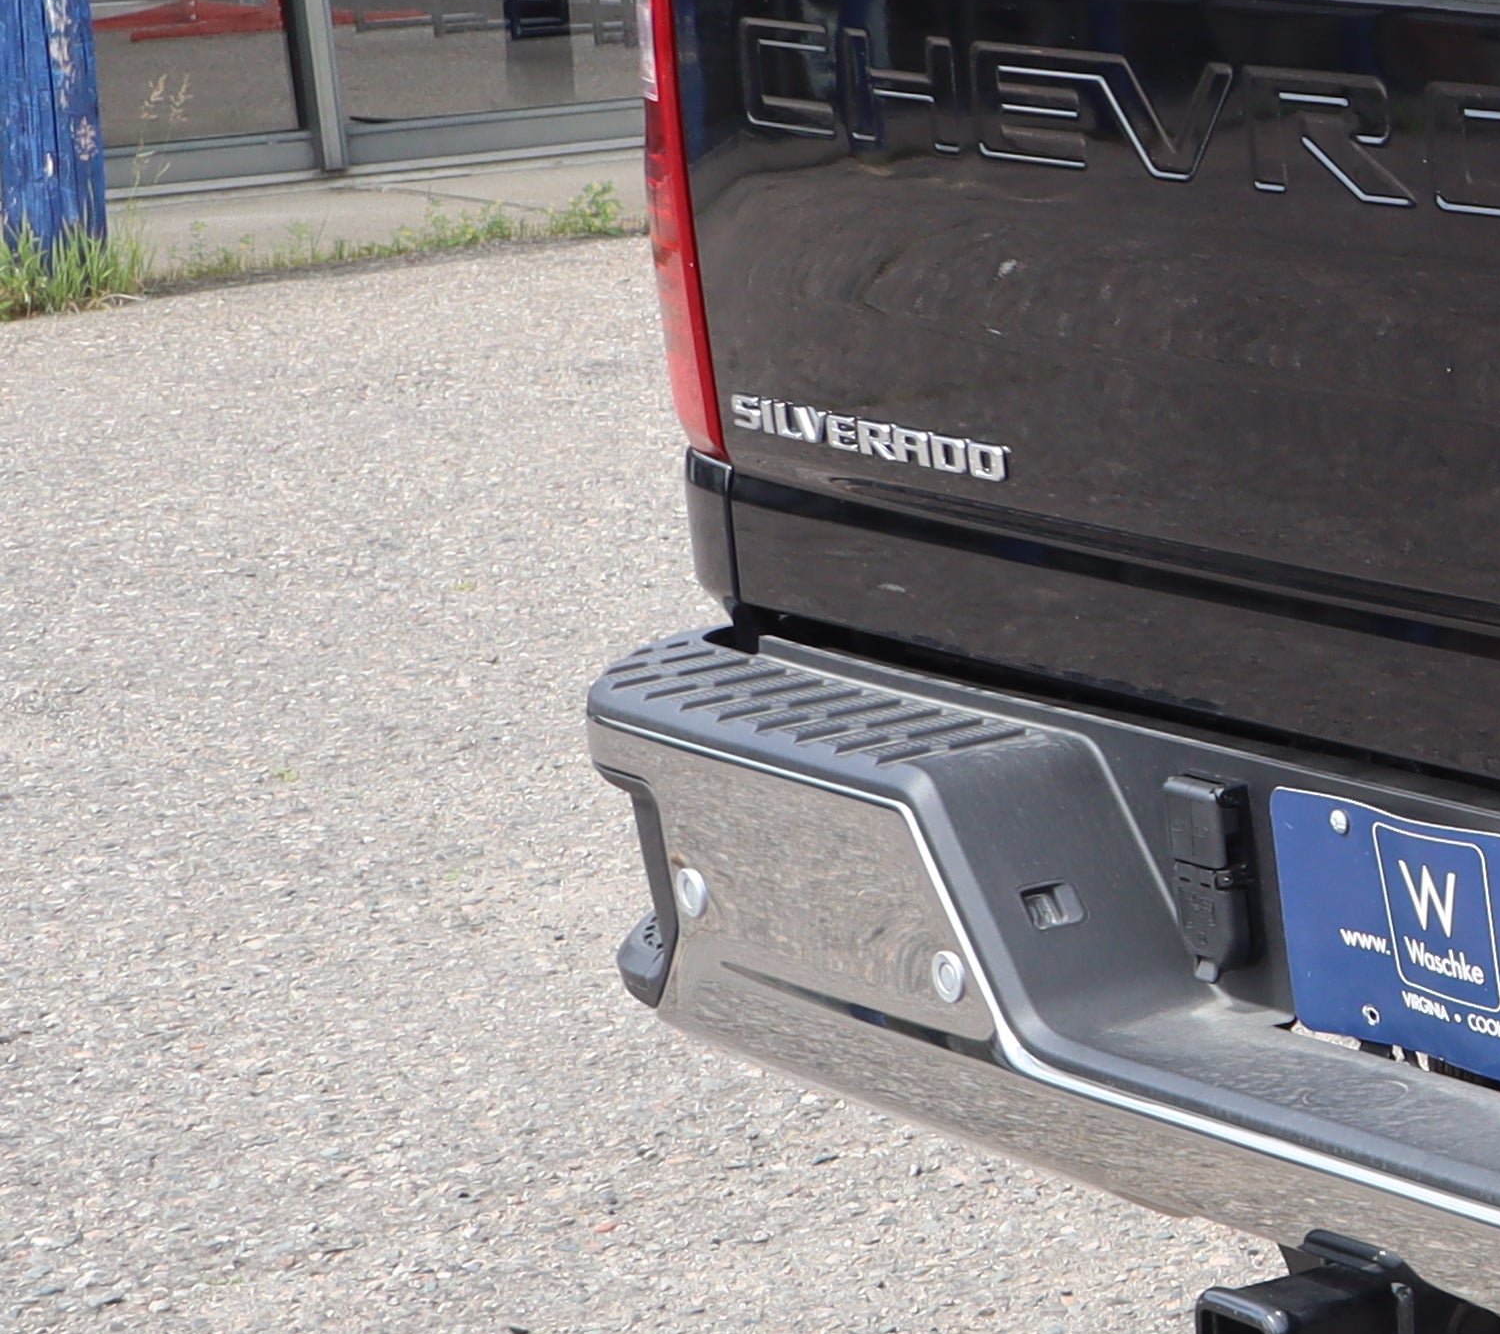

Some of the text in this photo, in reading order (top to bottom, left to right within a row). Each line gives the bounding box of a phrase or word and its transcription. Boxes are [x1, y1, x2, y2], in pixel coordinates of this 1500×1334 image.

[731, 394, 1010, 482] SILVERADO
[1399, 859, 1456, 938] W
[1340, 927, 1391, 956] www.
[1404, 936, 1484, 986] Waschke
[1402, 990, 1450, 1024] VIRGINIA
